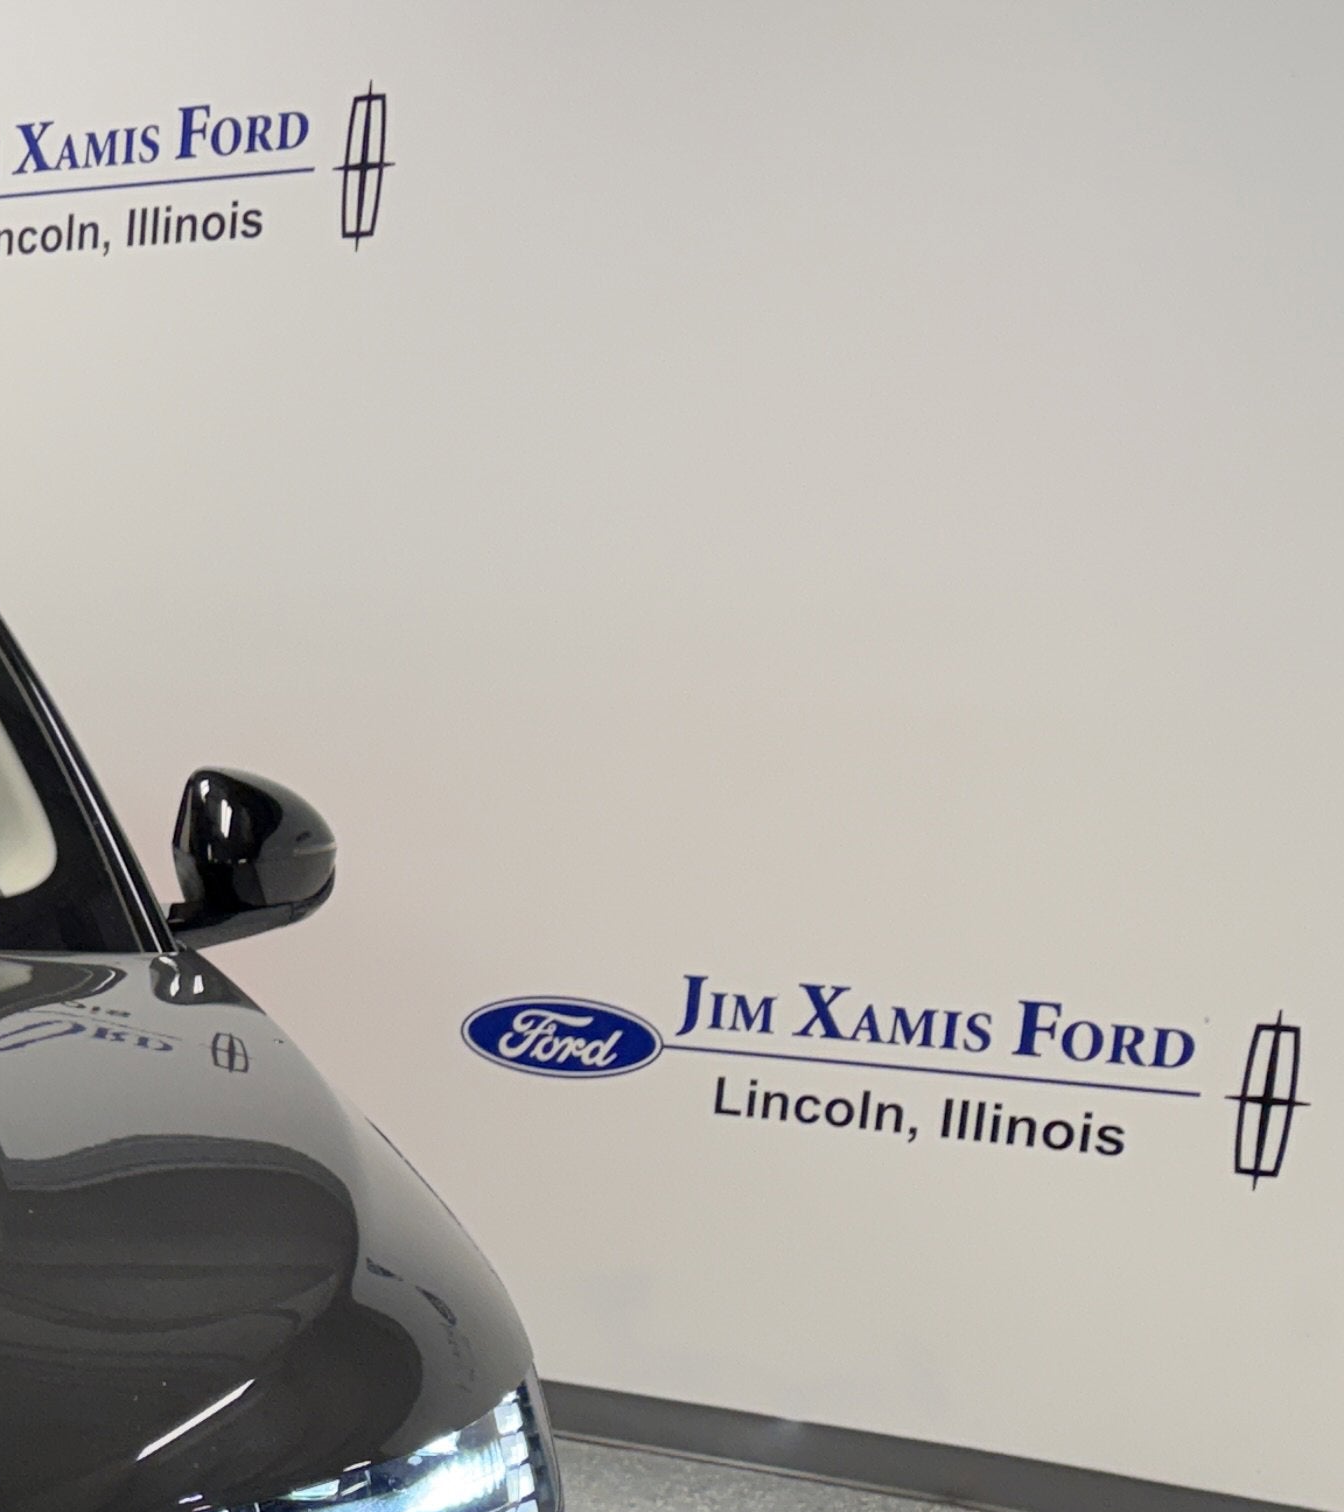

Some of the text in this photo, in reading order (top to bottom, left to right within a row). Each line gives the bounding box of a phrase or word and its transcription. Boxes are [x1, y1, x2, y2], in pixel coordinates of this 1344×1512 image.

[11, 120, 160, 175] XAMIS
[175, 103, 310, 161] FORD
[126, 200, 263, 248] Illinois
[499, 1009, 619, 1069] Ford
[675, 974, 1197, 1070] JIM XAMIS FORD
[713, 1075, 1127, 1157] Lincoln, Illinois
